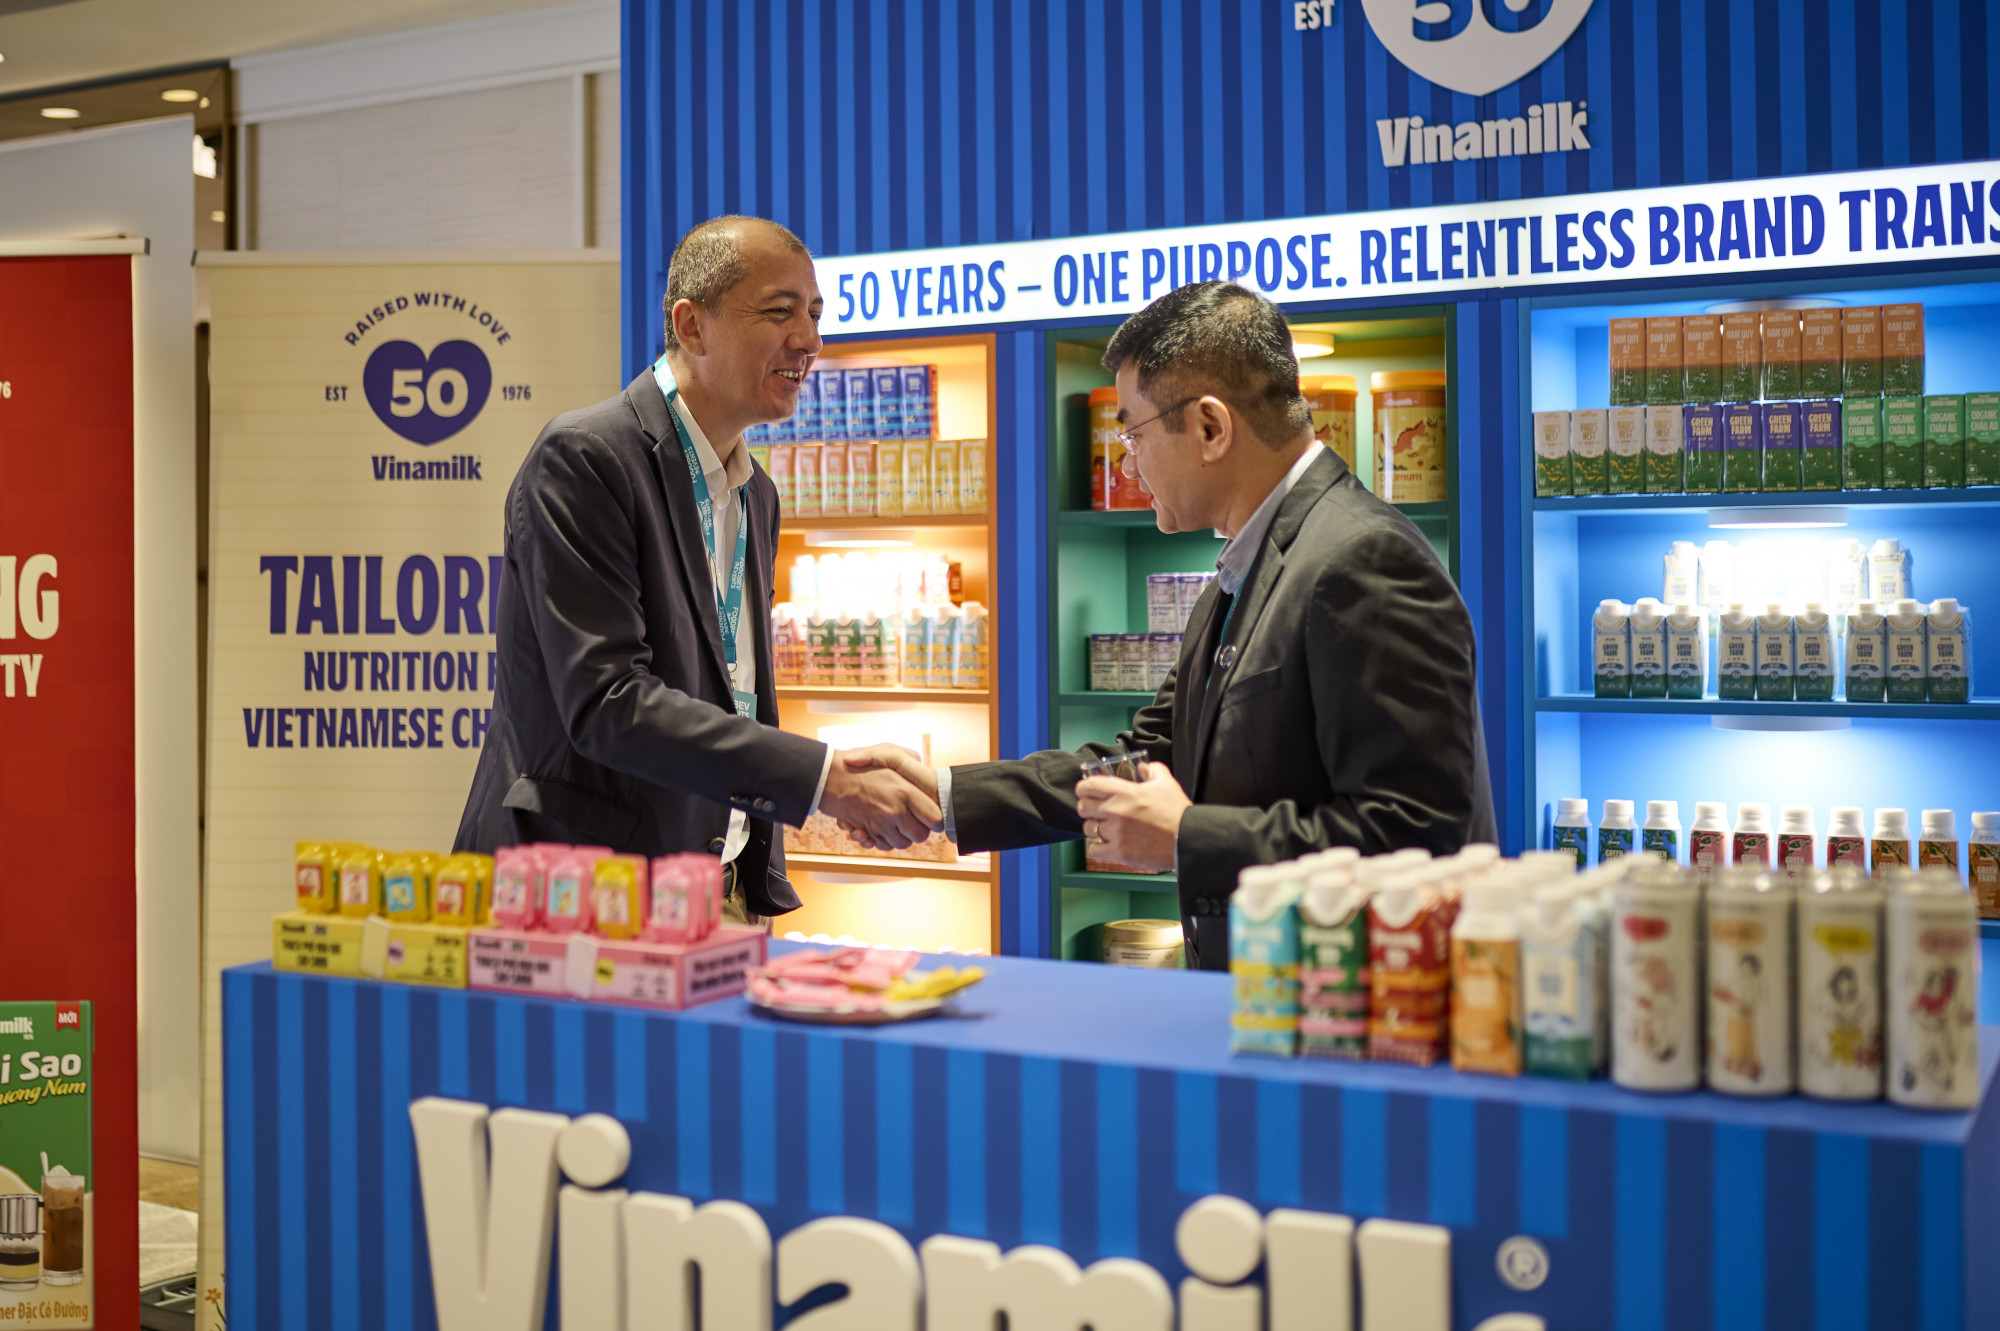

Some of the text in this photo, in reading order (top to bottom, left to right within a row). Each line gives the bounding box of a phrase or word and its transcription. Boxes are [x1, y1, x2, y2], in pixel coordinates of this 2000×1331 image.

[1295, 0, 1334, 30] EST
[1376, 101, 1591, 167] Vinamilk
[837, 271, 879, 323] 50
[890, 259, 1006, 318] YEARS
[1053, 249, 1130, 308] ONE
[1142, 231, 1348, 302] PURPOSE.
[1360, 207, 1636, 286] RELENTLESS
[1648, 193, 1825, 266] BRAND
[344, 292, 512, 346] RAISED WITH LOVE
[325, 368, 531, 418] EST 50 1976
[1691, 417, 1713, 426] GREEN
[1692, 426, 1712, 436] FARM
[1730, 416, 1752, 425] GREEN
[1731, 425, 1752, 435] FARM
[1769, 415, 1792, 424] GREEN
[1770, 424, 1791, 433] FARM
[1808, 413, 1832, 423] GREEN
[1810, 422, 1831, 432] FARM
[371, 455, 482, 481] Vinamilk
[736, 557, 745, 591] FOODBEV
[0, 654, 43, 697] TY
[304, 651, 478, 691] NUTRITION
[242, 708, 443, 748] VIETNAMESE
[19, 1051, 82, 1081] Sao
[41, 1078, 87, 1098] Nam
